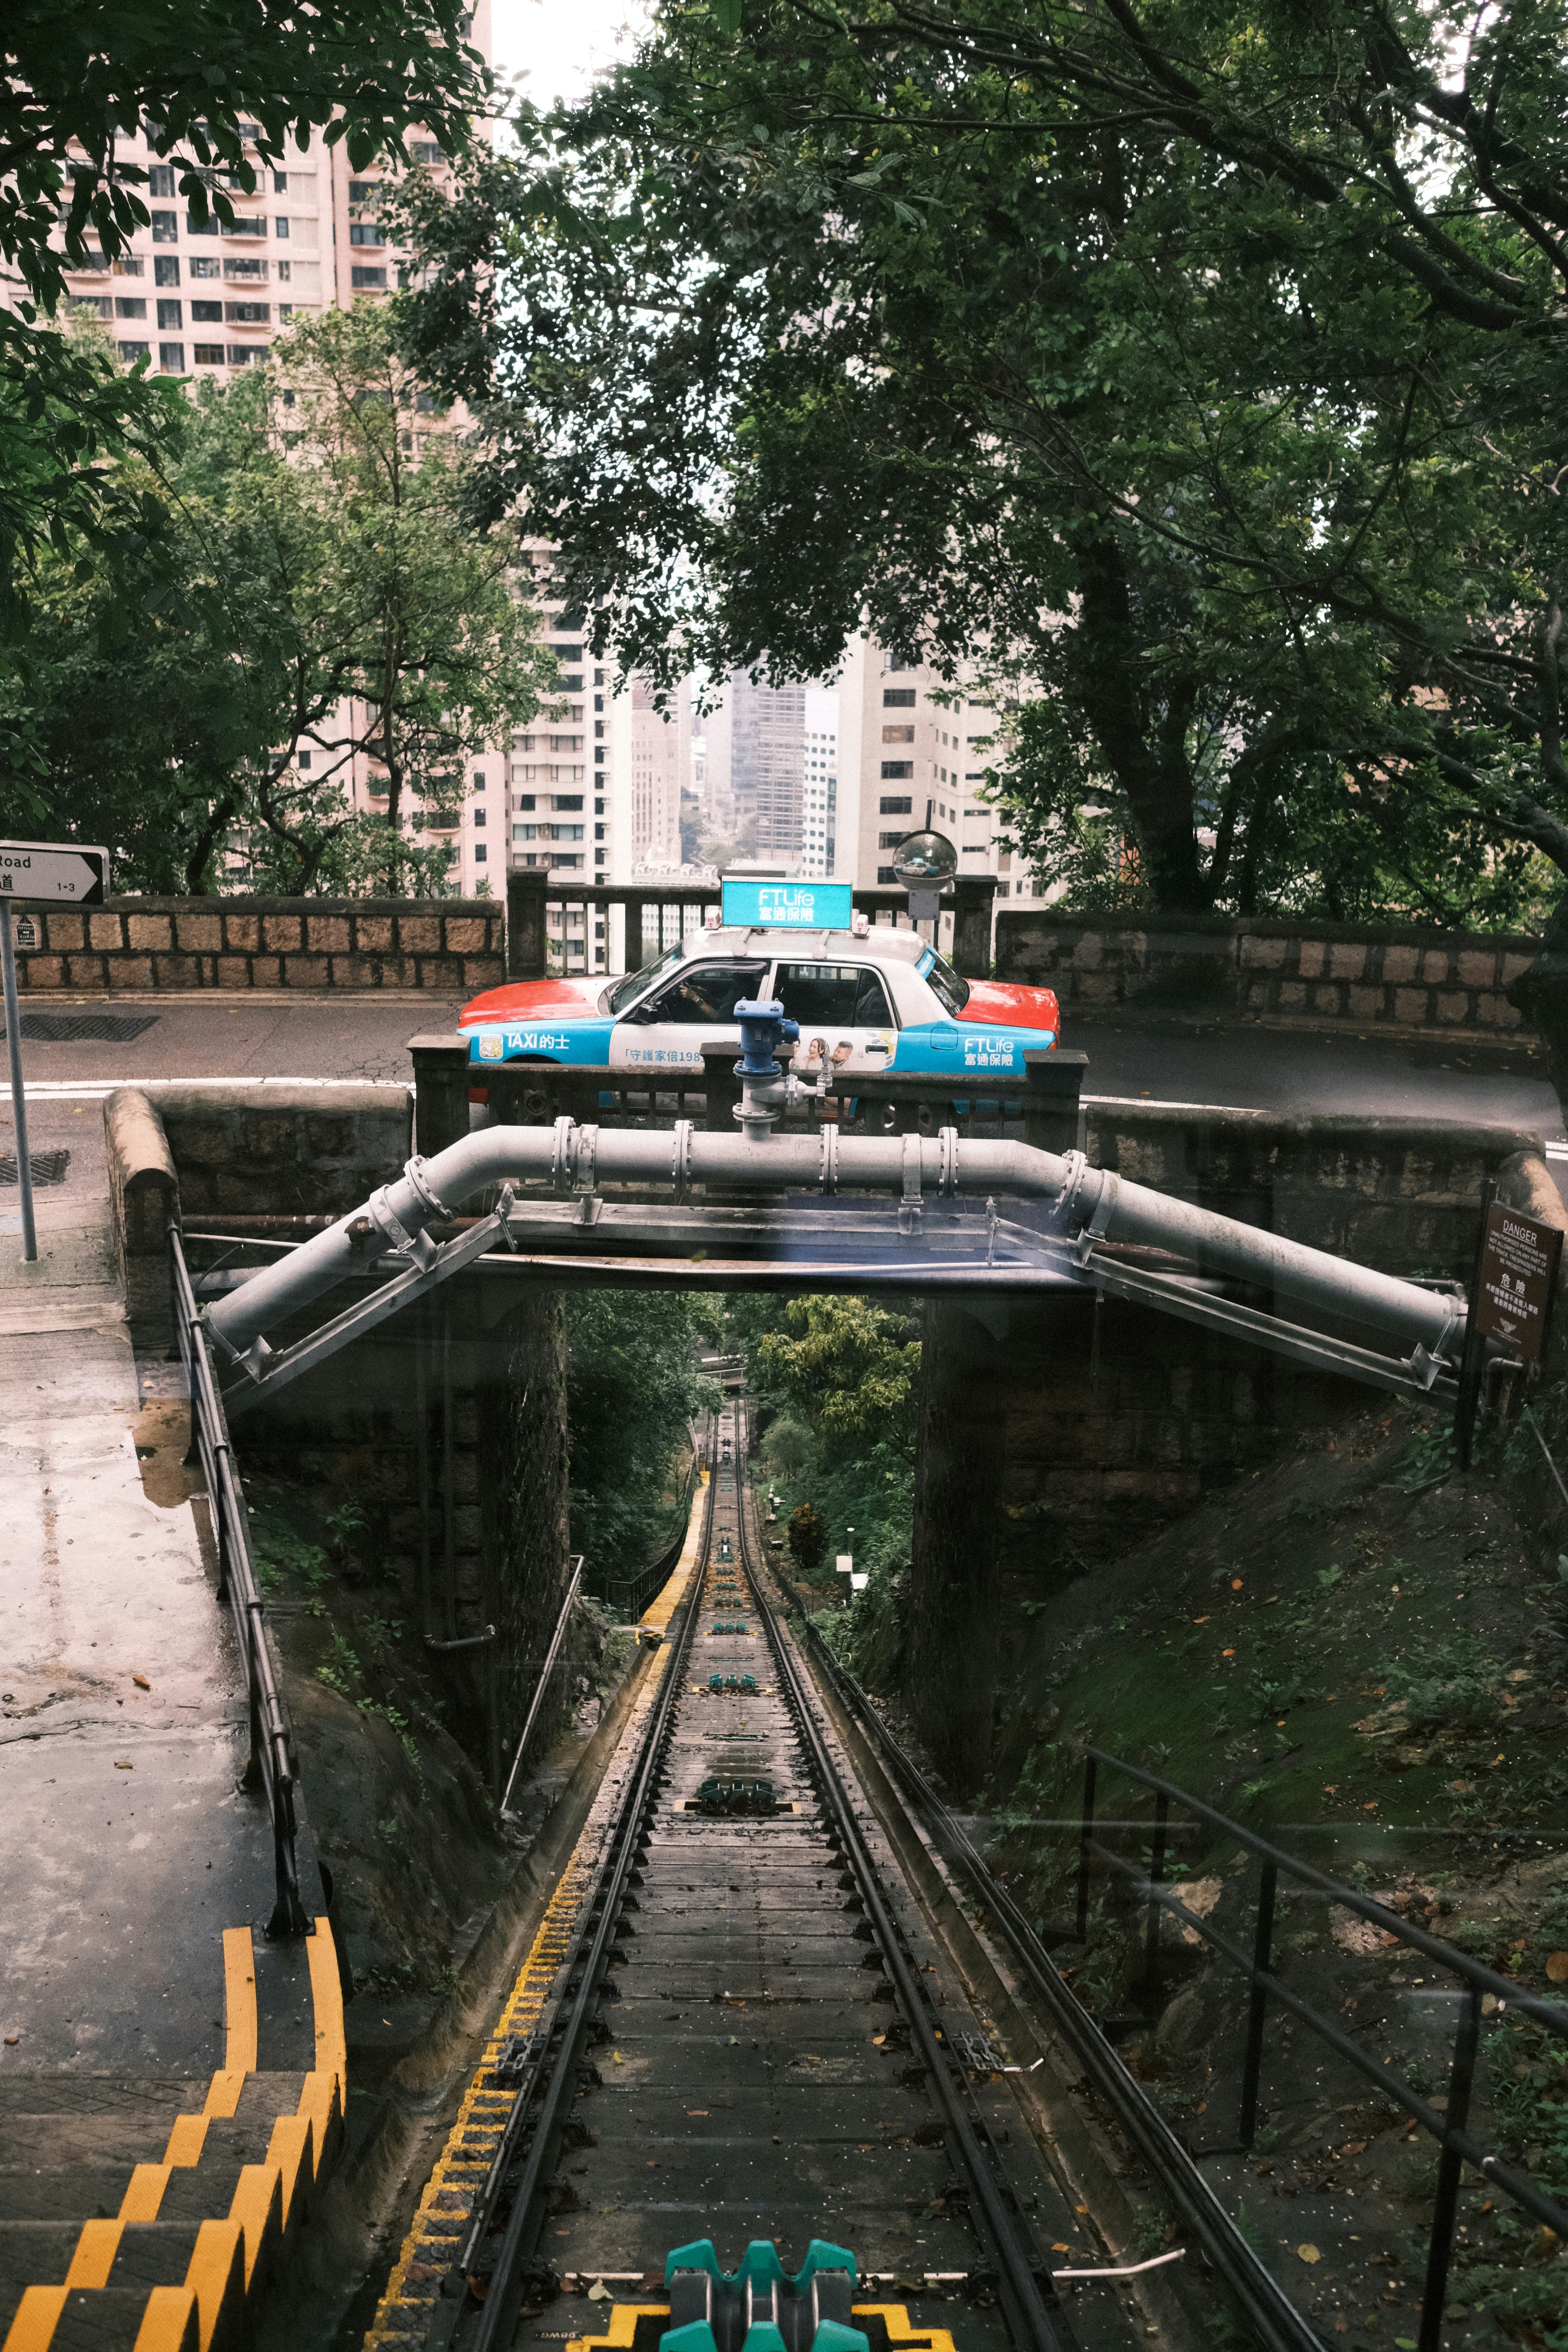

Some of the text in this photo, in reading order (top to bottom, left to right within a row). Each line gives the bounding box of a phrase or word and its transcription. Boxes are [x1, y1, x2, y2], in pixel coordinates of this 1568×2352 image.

[57, 882, 75, 891] 1-3
[759, 889, 815, 906] FTLife
[759, 907, 814, 922] 富通保險
[506, 1033, 537, 1048] TAXI
[539, 1034, 570, 1049] 的士
[965, 1038, 1014, 1053] FTLife
[965, 1054, 1013, 1066] 富通保險
[1503, 1219, 1537, 1244] DANGER
[1497, 1240, 1515, 1254] ALLOWED
[1530, 1256, 1540, 1265] PART
[1520, 1243, 1539, 1257] PERSONS
[1505, 1260, 1531, 1277] PROSECUTED
[1510, 1254, 1536, 1272] TRESPASSERS
[1537, 1268, 1546, 1276] WILL
